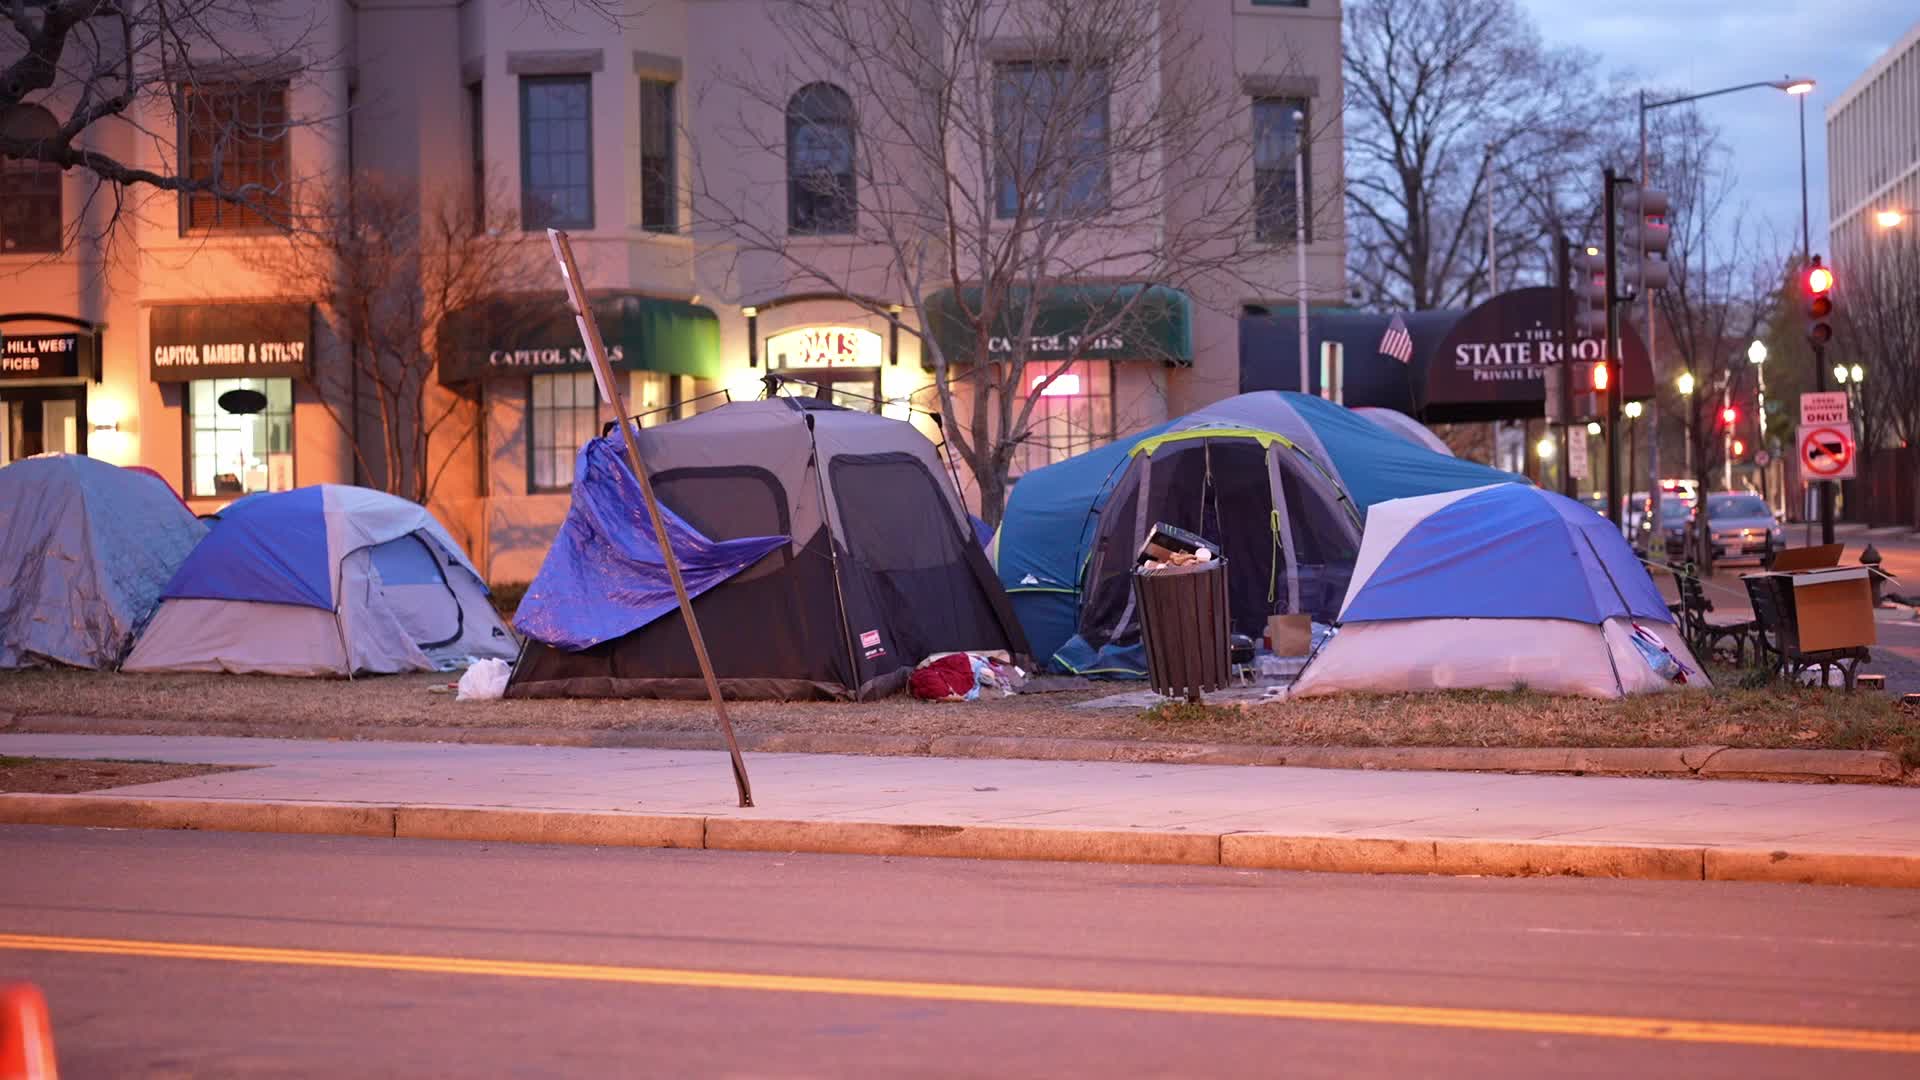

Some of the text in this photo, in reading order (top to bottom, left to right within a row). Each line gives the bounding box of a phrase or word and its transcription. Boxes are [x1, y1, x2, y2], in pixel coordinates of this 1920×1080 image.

[1526, 329, 1551, 340] THE
[7, 338, 75, 354] HILL WEST
[1455, 342, 1532, 366] STATE
[154, 345, 200, 366] CAPITOL
[202, 344, 245, 364] BARBER
[248, 344, 257, 363] &
[488, 348, 566, 366] CAPITOL
[1473, 367, 1523, 381] PRIVATE
